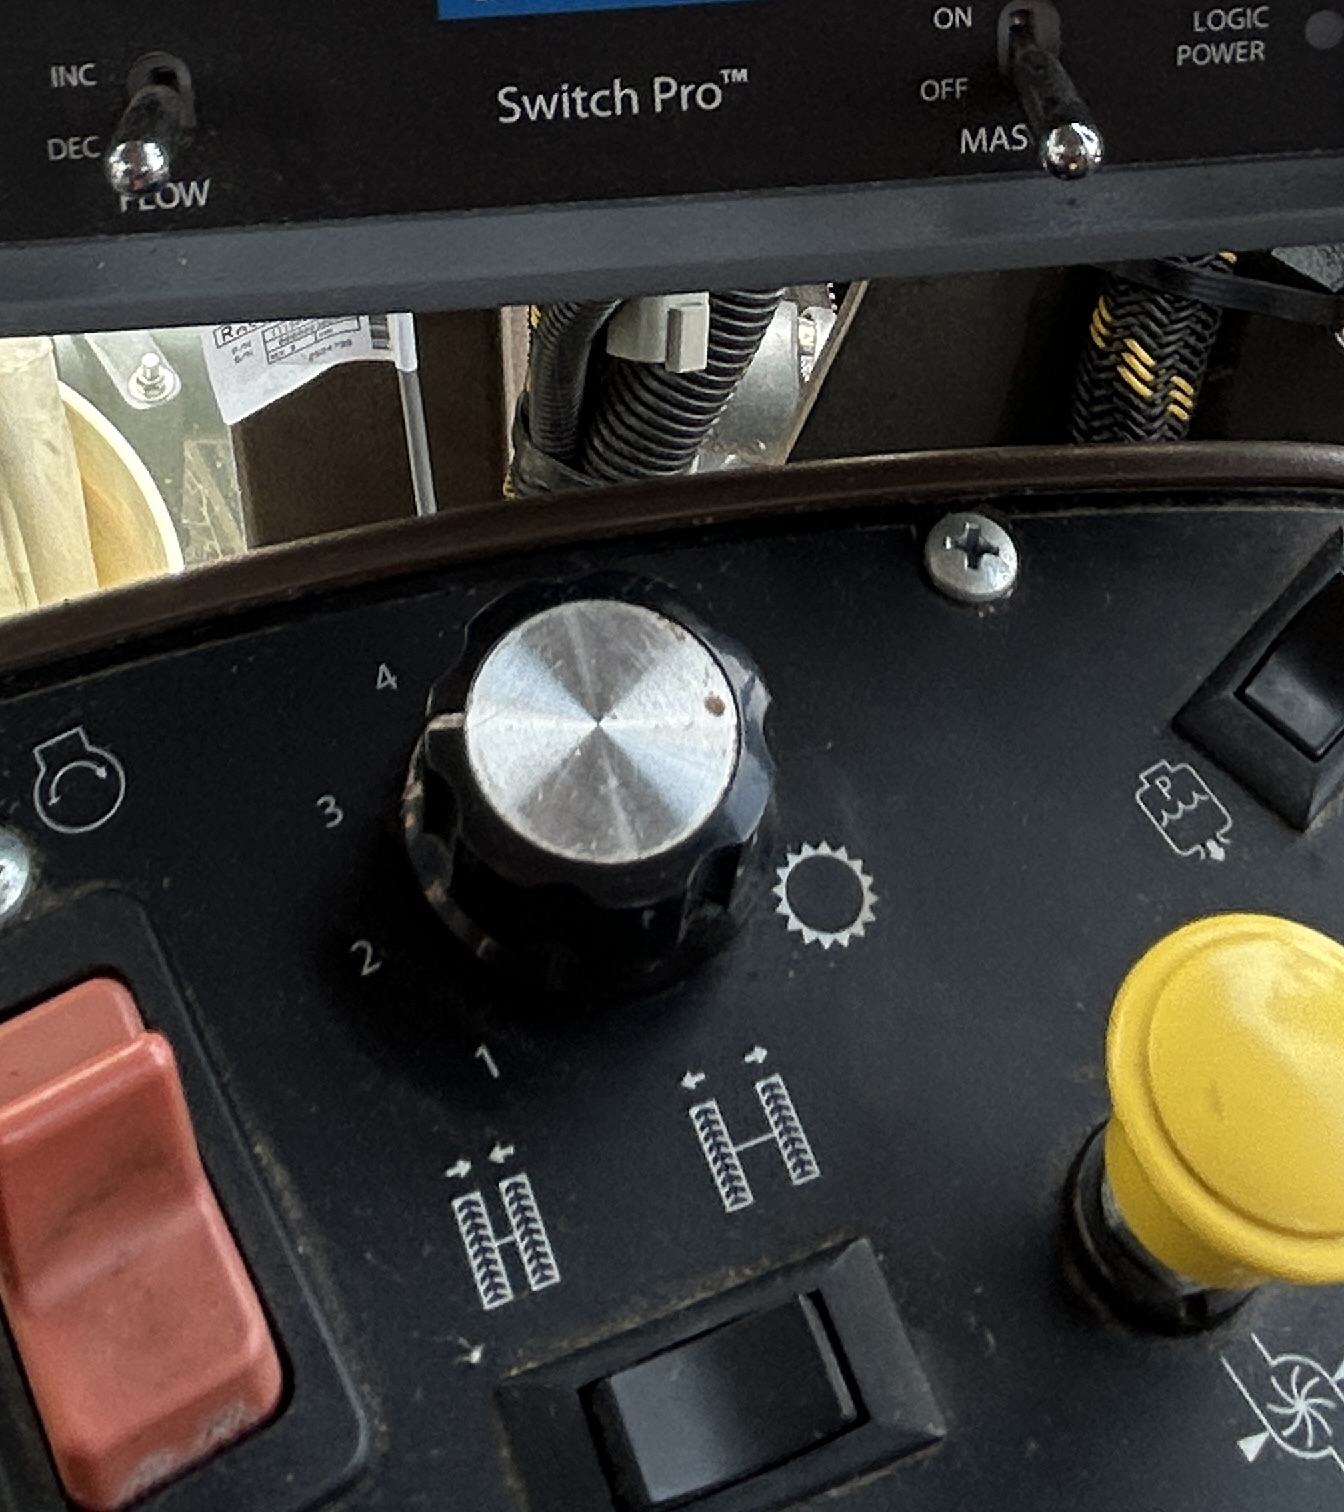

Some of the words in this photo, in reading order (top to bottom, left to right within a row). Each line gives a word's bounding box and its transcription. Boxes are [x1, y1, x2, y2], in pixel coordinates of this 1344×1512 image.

[933, 6, 972, 30] ON
[1192, 5, 1270, 32] LOGIC
[1177, 41, 1266, 66] POWER
[51, 63, 97, 88] INC
[497, 79, 639, 124] Switch
[920, 77, 968, 101] OFF
[47, 136, 101, 161] DEC
[376, 664, 398, 690] 4
[316, 795, 344, 828] 3
[350, 940, 382, 975] 2
[475, 1044, 499, 1078] 1
